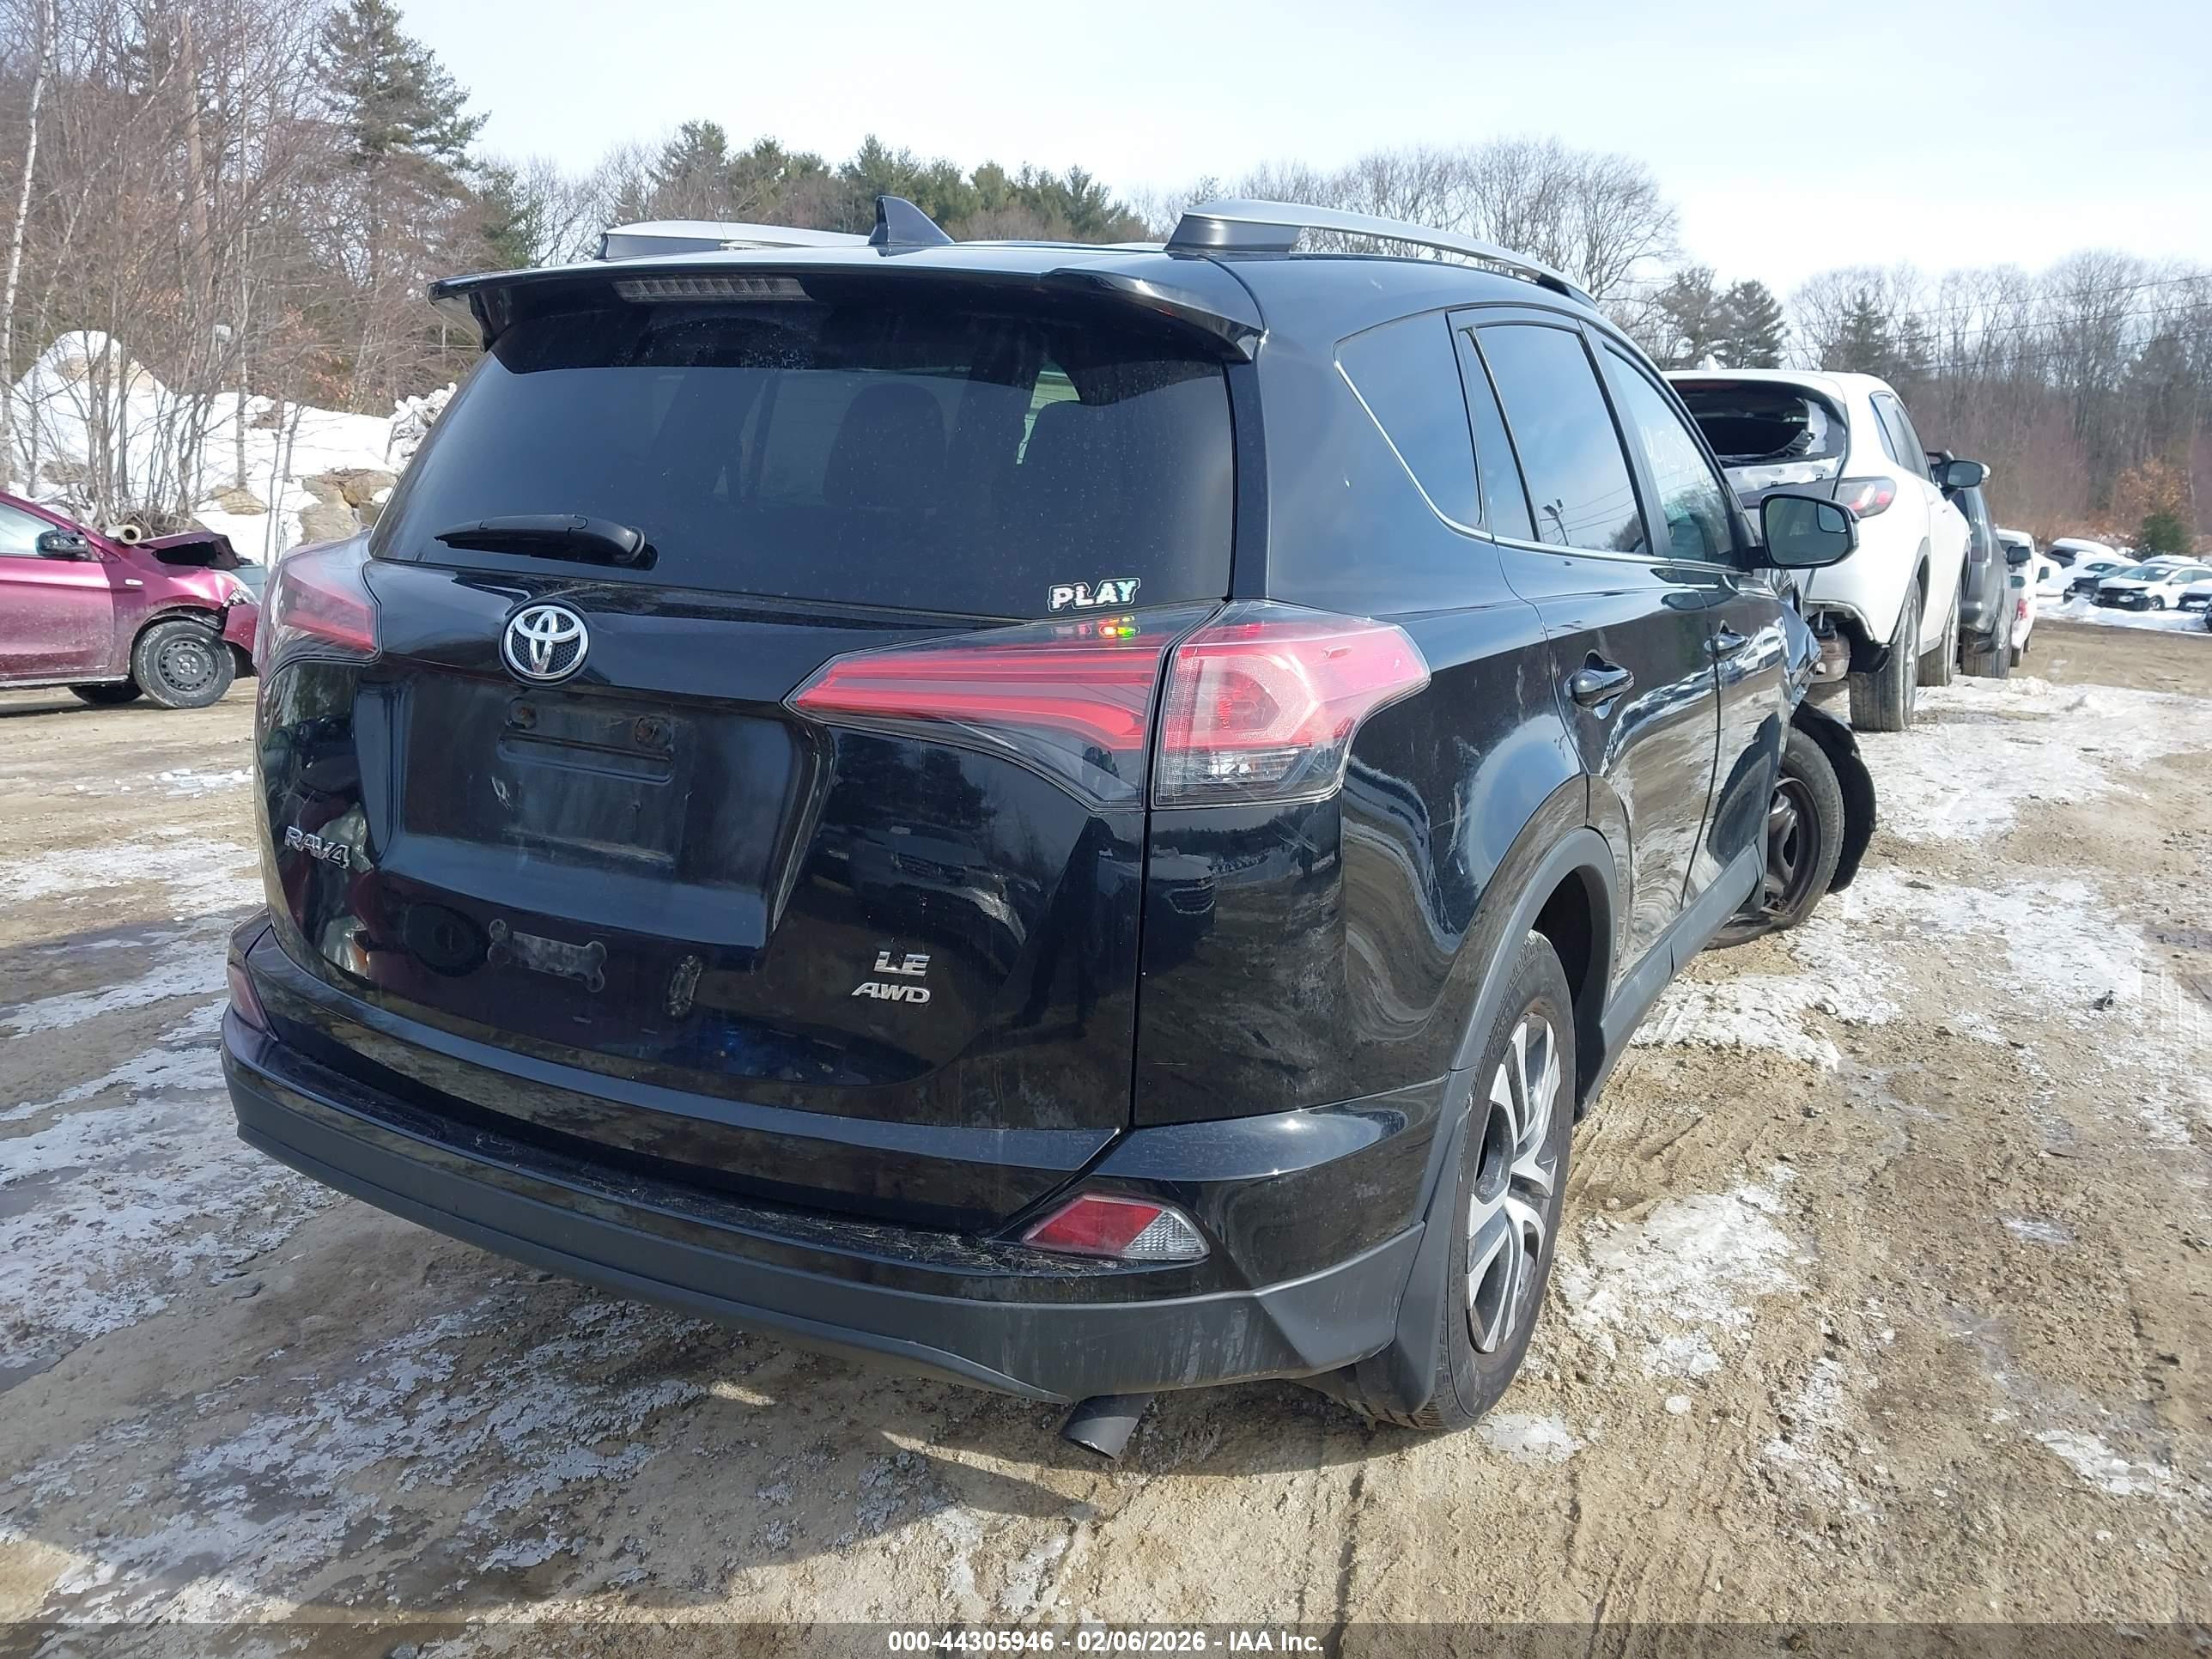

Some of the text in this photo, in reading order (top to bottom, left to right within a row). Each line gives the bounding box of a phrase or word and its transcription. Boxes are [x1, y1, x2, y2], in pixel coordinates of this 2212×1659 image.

[1049, 579, 1139, 611] PLAY
[284, 825, 351, 869] RAV4
[873, 951, 931, 976] LE
[851, 981, 931, 1004] AWD
